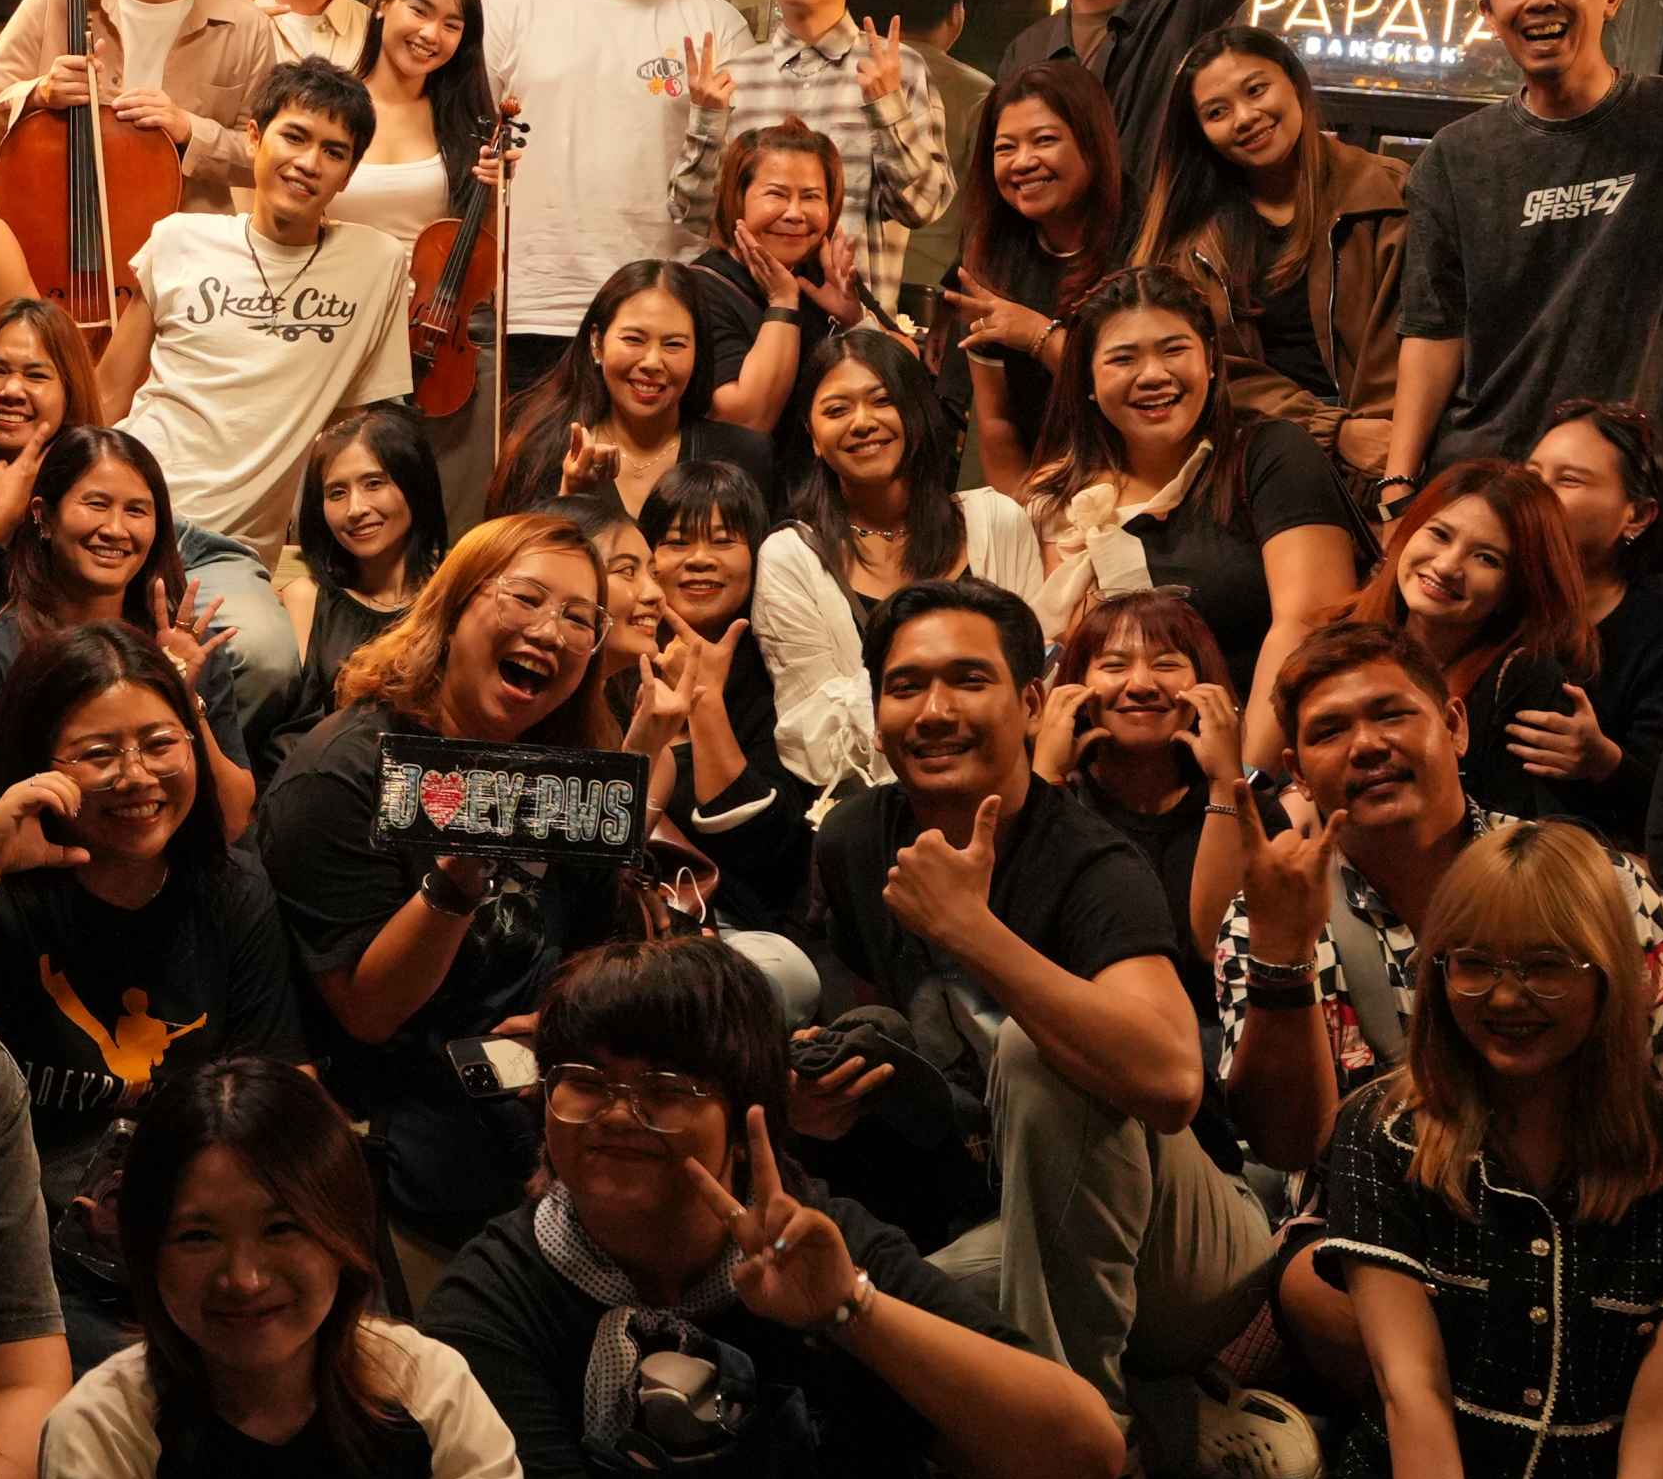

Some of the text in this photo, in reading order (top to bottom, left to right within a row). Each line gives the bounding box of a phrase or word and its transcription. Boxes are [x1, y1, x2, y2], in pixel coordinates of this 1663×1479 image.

[1305, 36, 1464, 65] BANGKOK
[1521, 182, 1595, 227] GENIE
[1536, 198, 1595, 224] FEST
[187, 276, 359, 327] Skate City
[388, 764, 634, 846] JEY PWS
